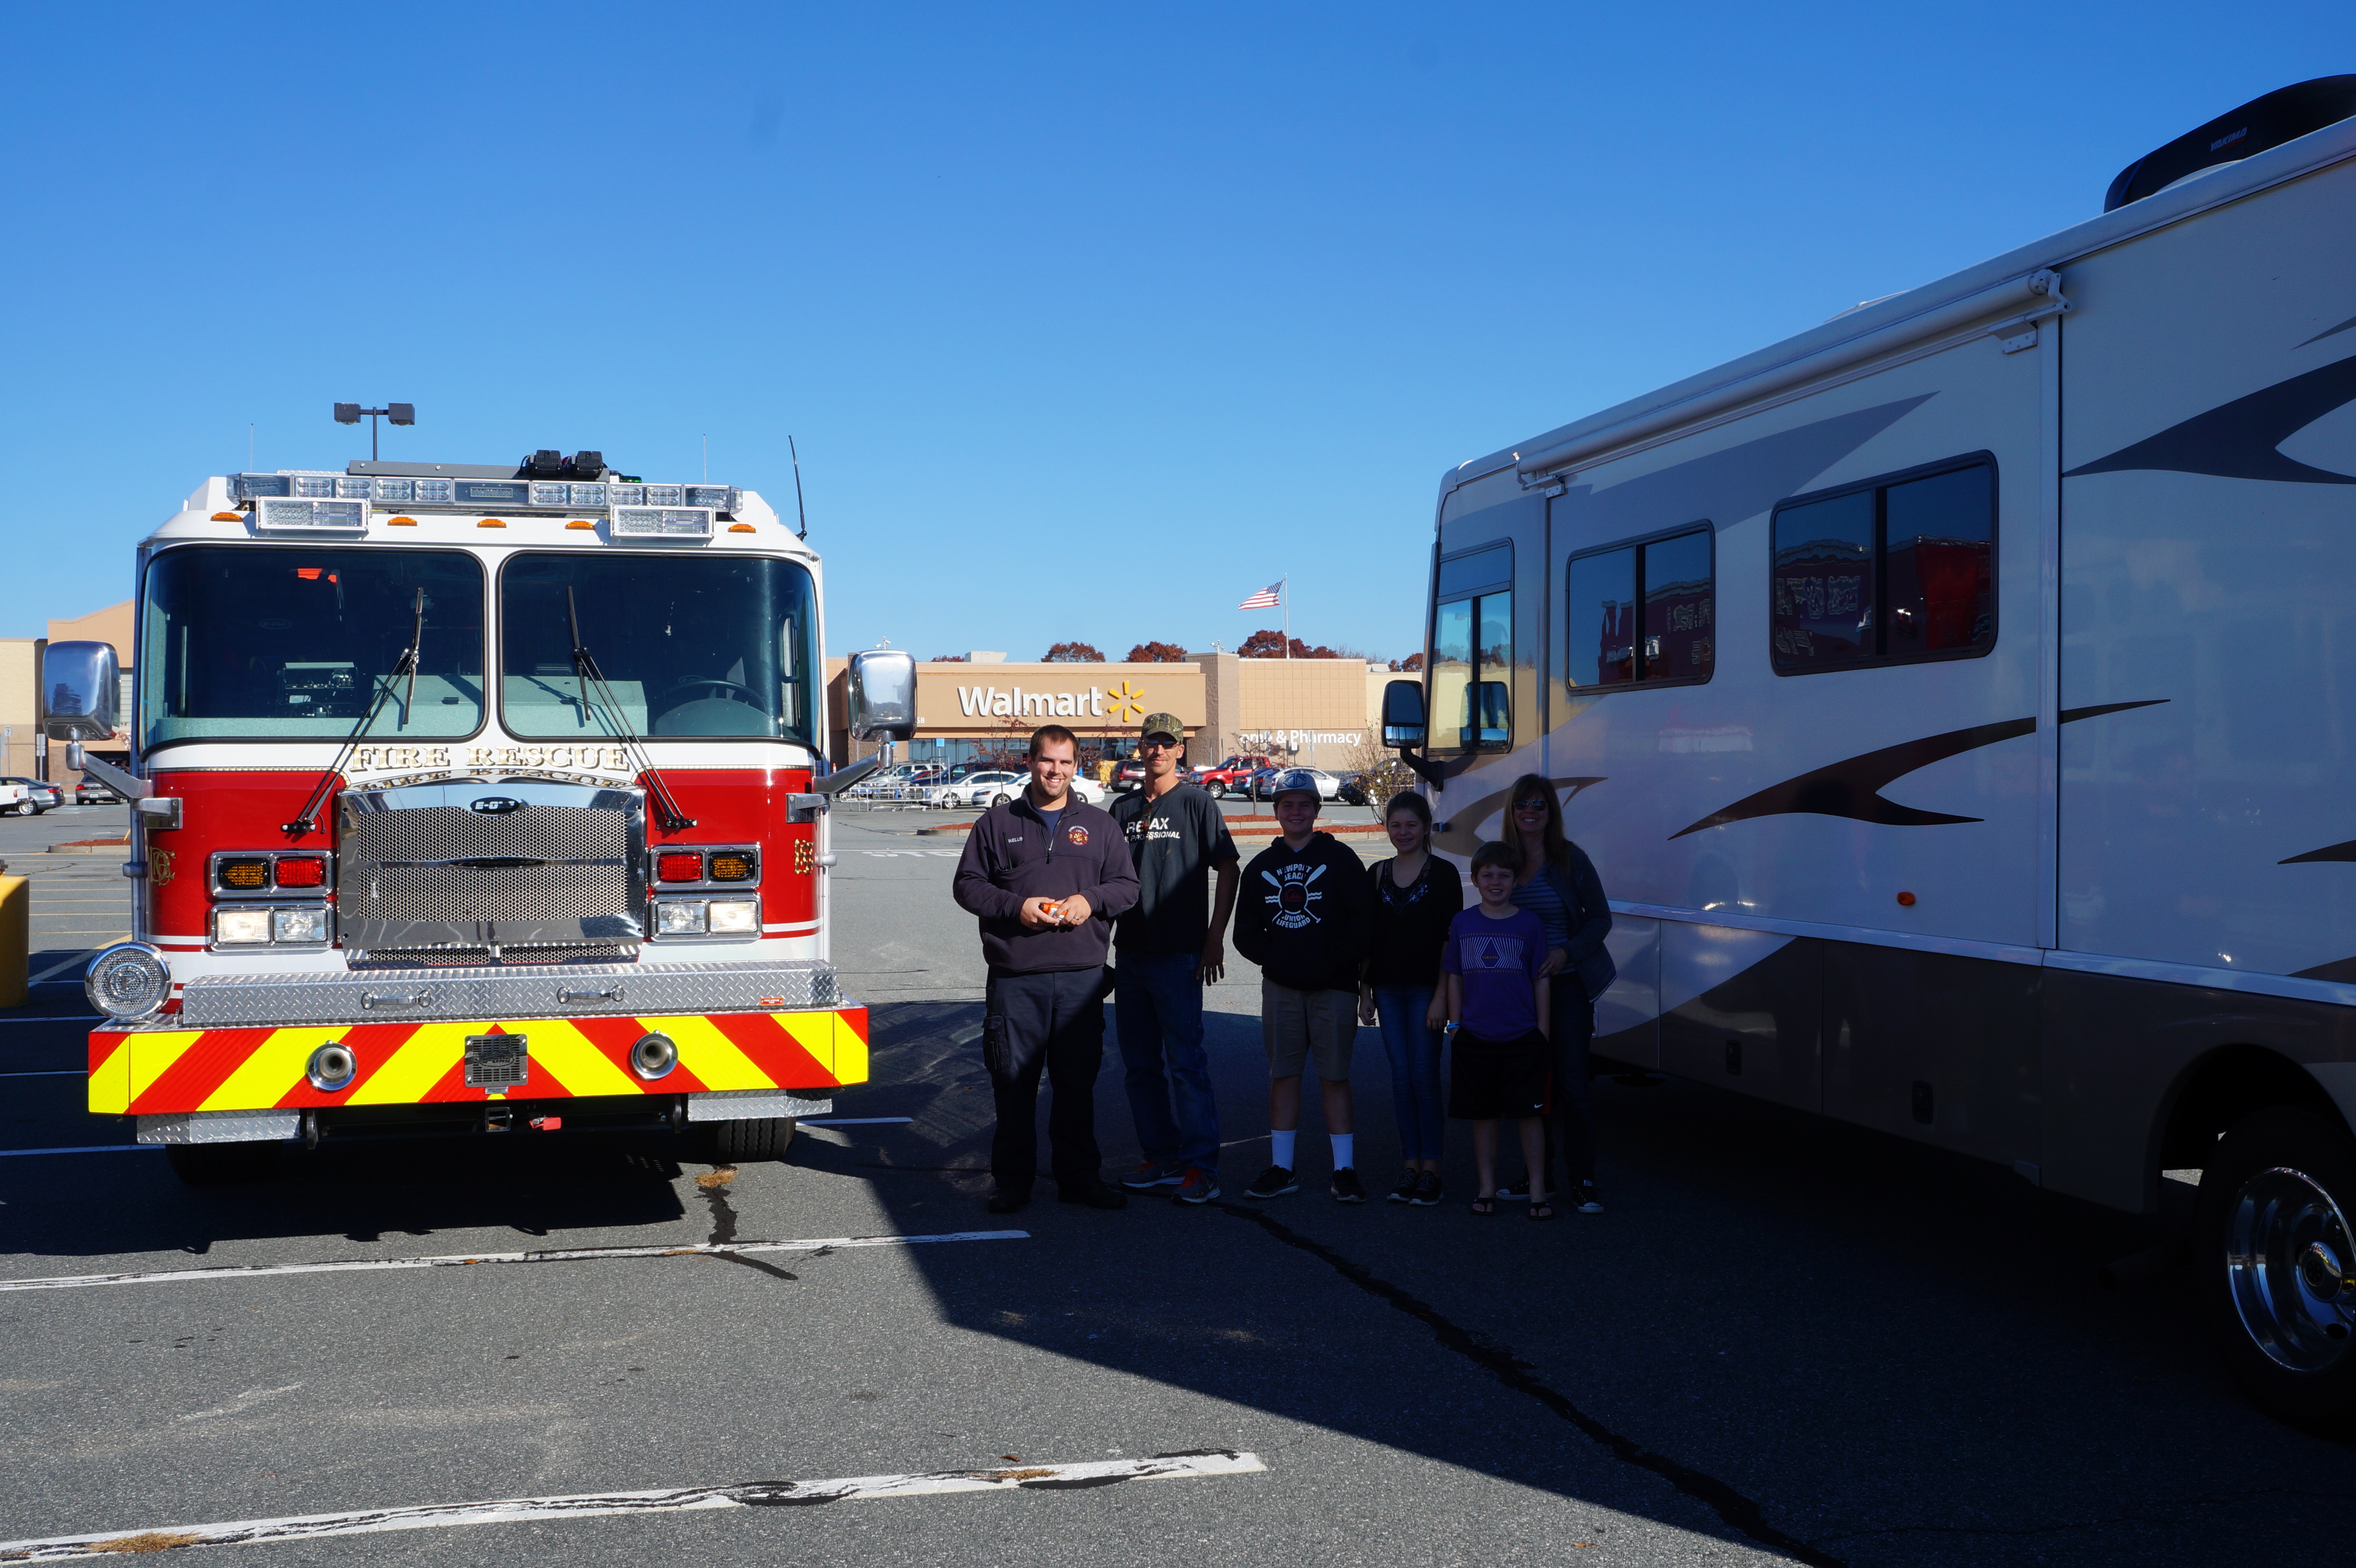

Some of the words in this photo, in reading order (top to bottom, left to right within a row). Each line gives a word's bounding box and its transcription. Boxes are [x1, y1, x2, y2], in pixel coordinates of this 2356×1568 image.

[2210, 126, 2247, 152] YAKIMA
[957, 686, 1102, 717] Walmart
[1276, 730, 1287, 743] &
[349, 746, 451, 773] FIRE
[465, 746, 630, 772] RESCUE
[1126, 817, 1169, 834] REAX
[1130, 831, 1180, 841] PROESSIONAL
[1276, 917, 1311, 929] LIFEGUARD
